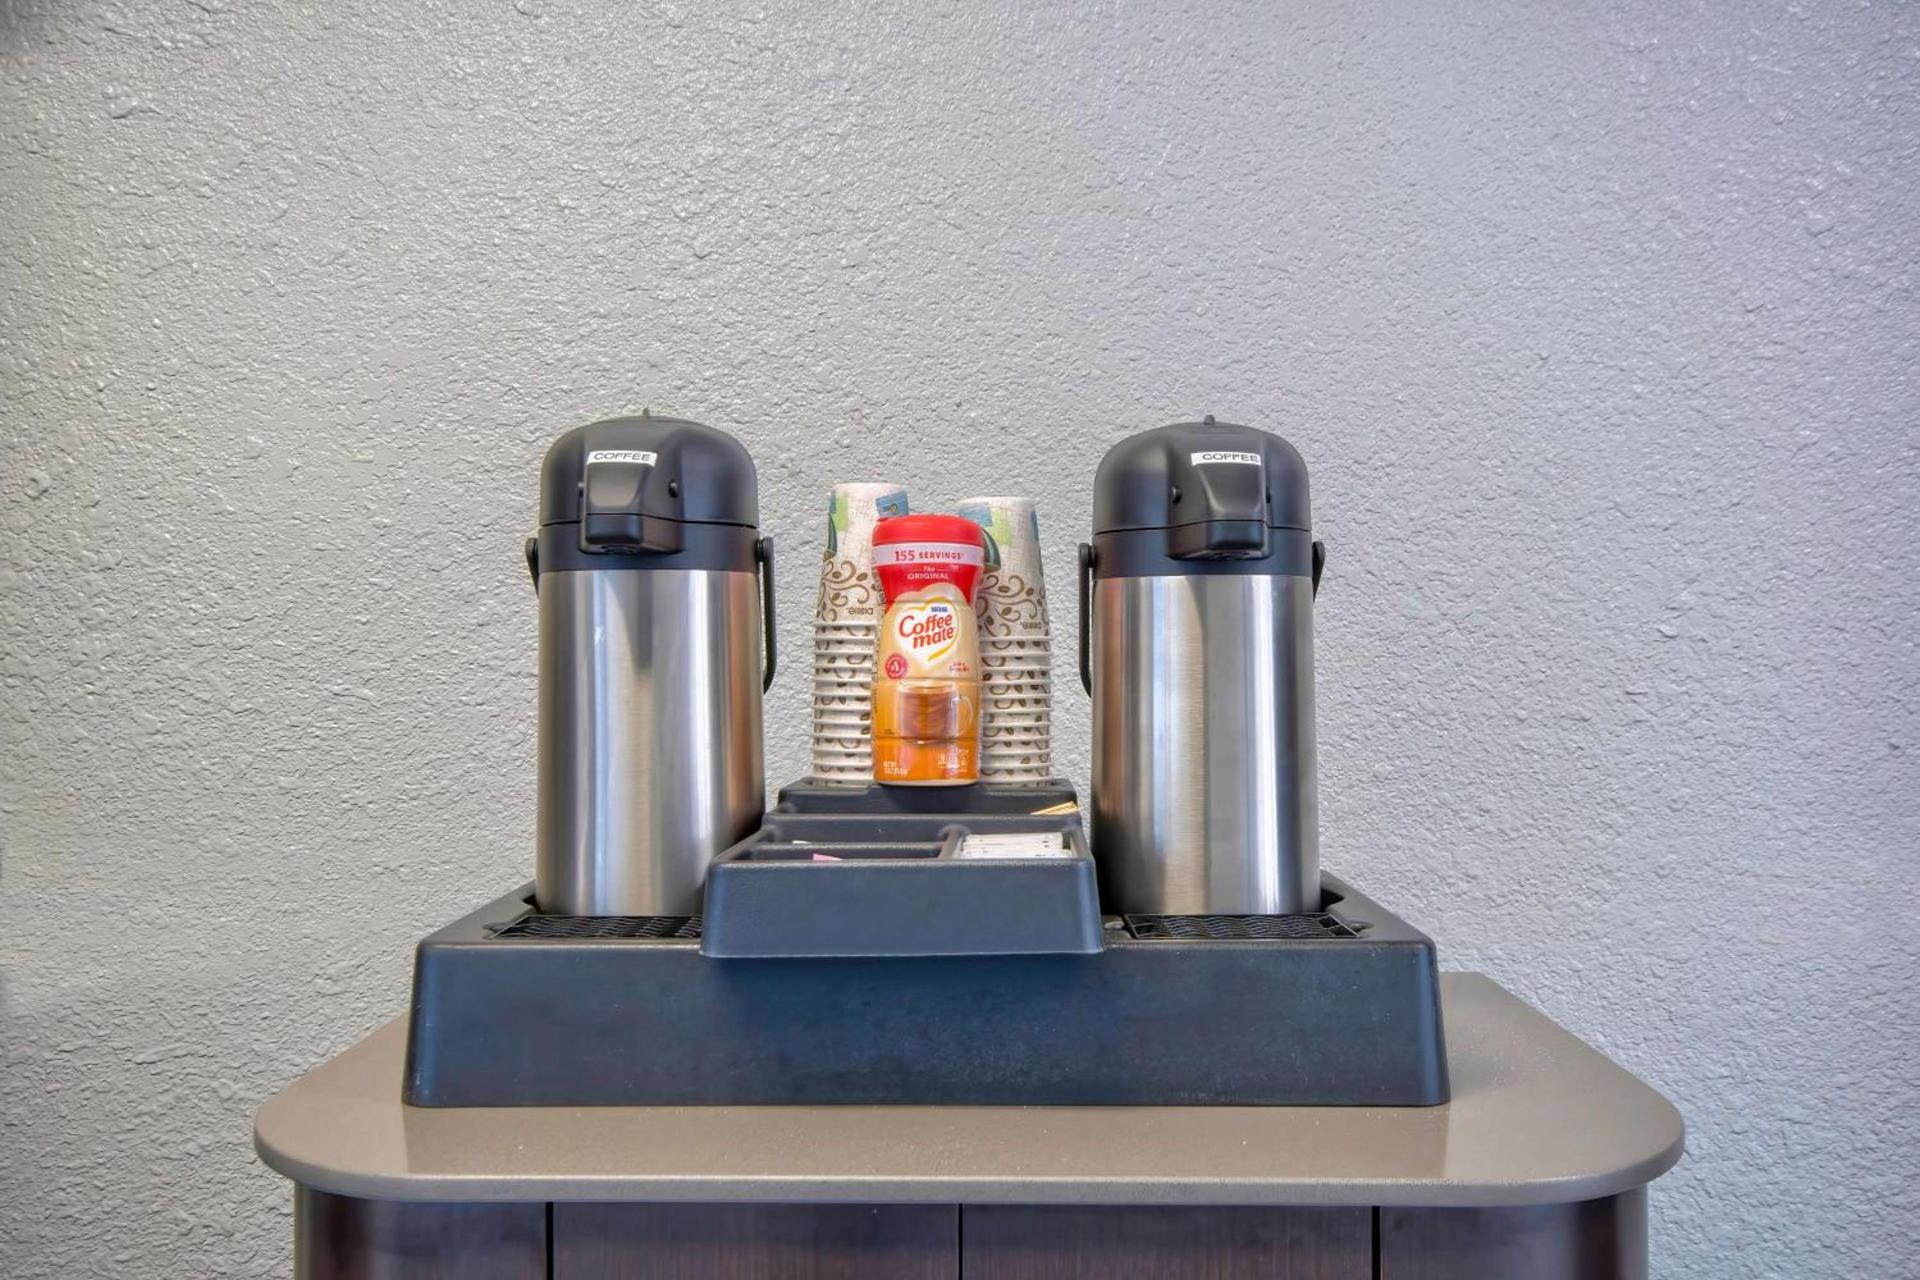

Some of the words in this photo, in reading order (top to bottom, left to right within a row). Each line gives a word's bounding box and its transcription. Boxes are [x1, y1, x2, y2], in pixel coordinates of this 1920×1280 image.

[593, 452, 652, 462] COFFEE
[1202, 453, 1259, 463] COFFEE
[895, 550, 916, 562] 155
[918, 551, 961, 560] SERVINGS
[907, 572, 949, 580] ORIGINAL
[899, 614, 953, 638] Coffee
[912, 626, 955, 649] mate
